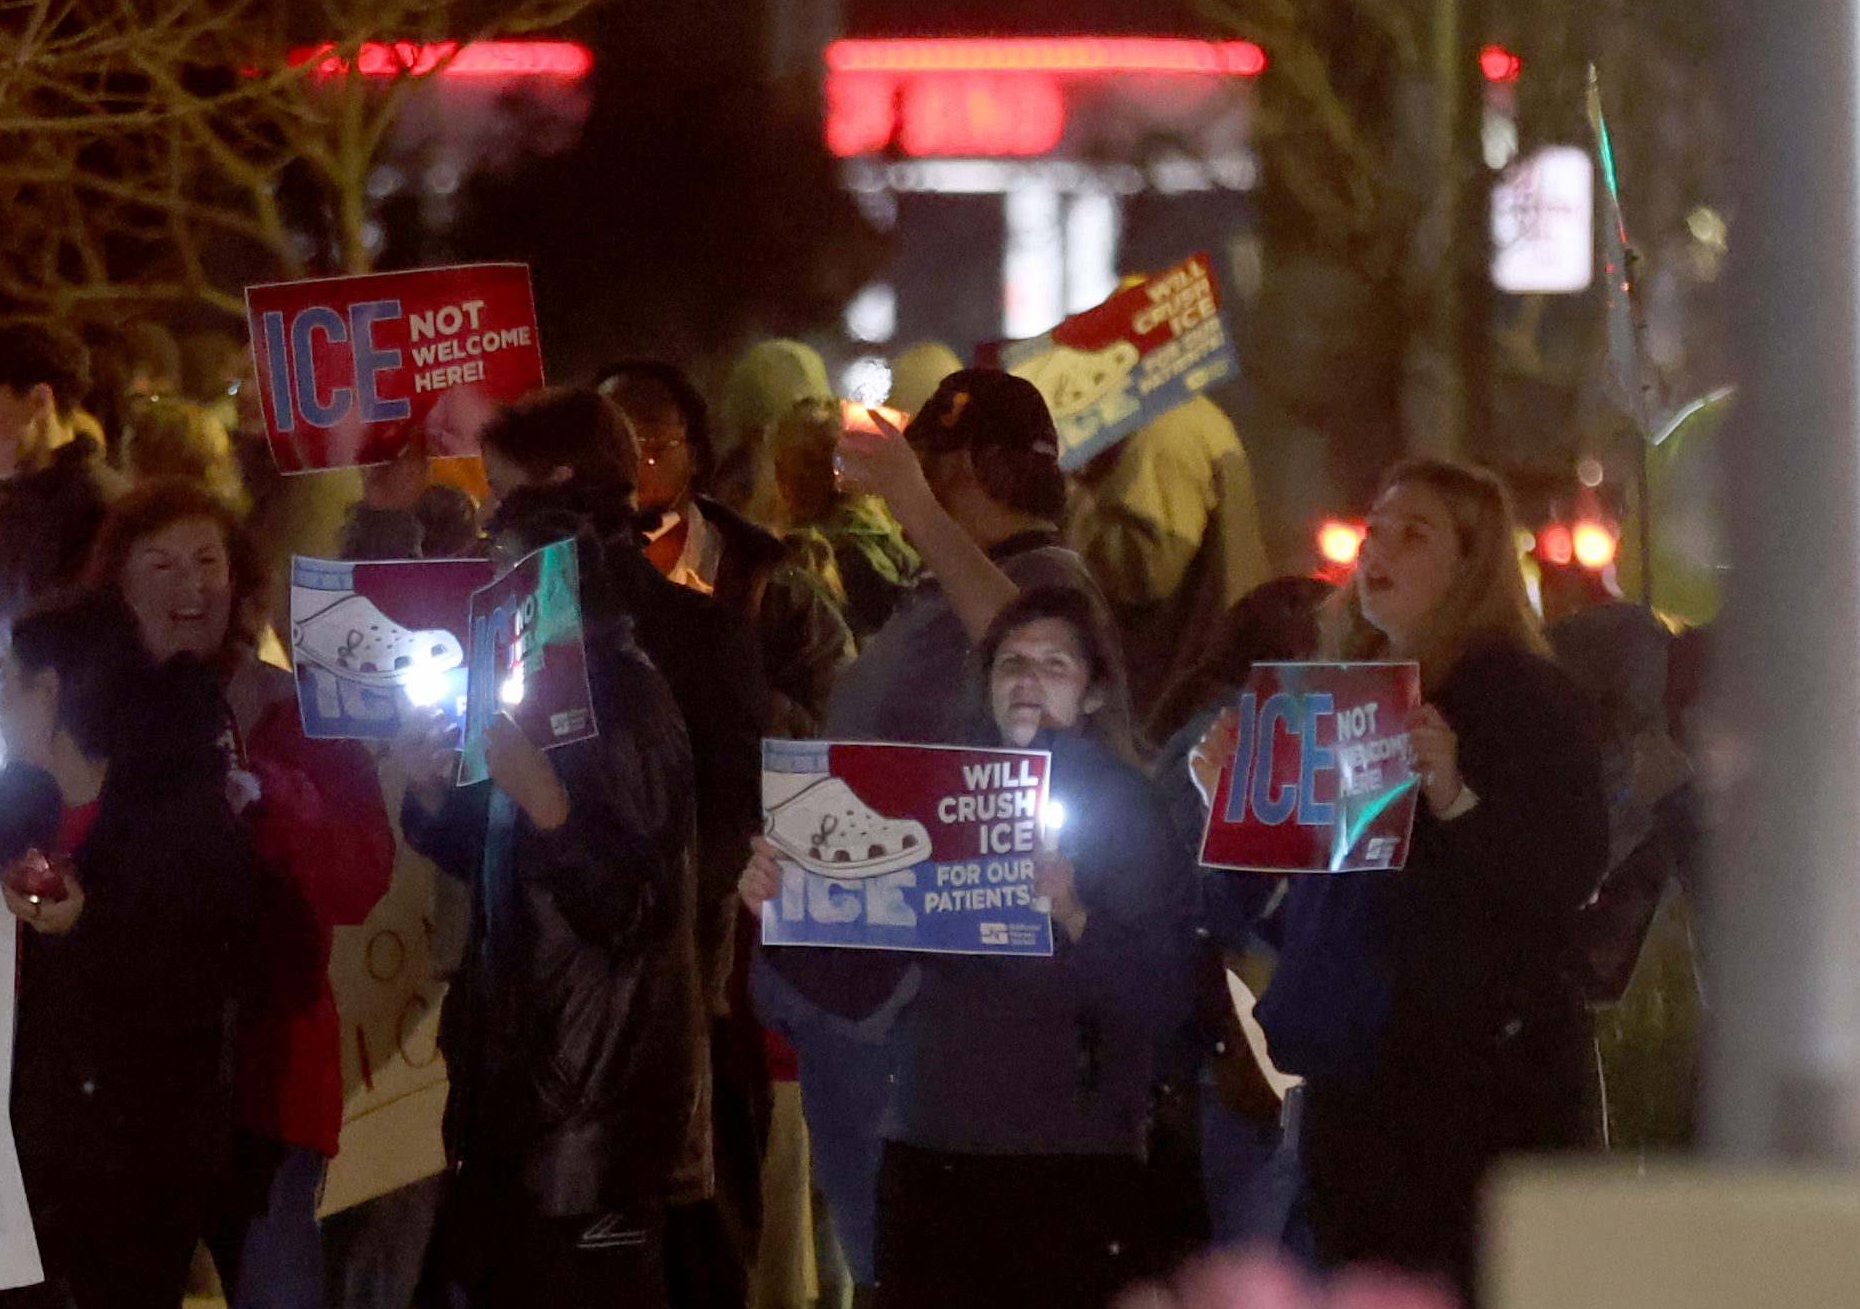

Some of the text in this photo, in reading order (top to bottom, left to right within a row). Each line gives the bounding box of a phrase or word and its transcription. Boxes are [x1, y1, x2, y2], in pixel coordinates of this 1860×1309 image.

[408, 299, 485, 343] NOT
[262, 299, 412, 433] ICE
[411, 325, 533, 369] WELCOME
[414, 360, 487, 394] HERE!
[1336, 701, 1379, 742] NOT
[962, 759, 1040, 792] WILL
[1223, 691, 1335, 826] ICE
[937, 788, 1038, 825] CRUSH
[978, 820, 1035, 856] ICE
[936, 858, 1035, 888] FOR OUR
